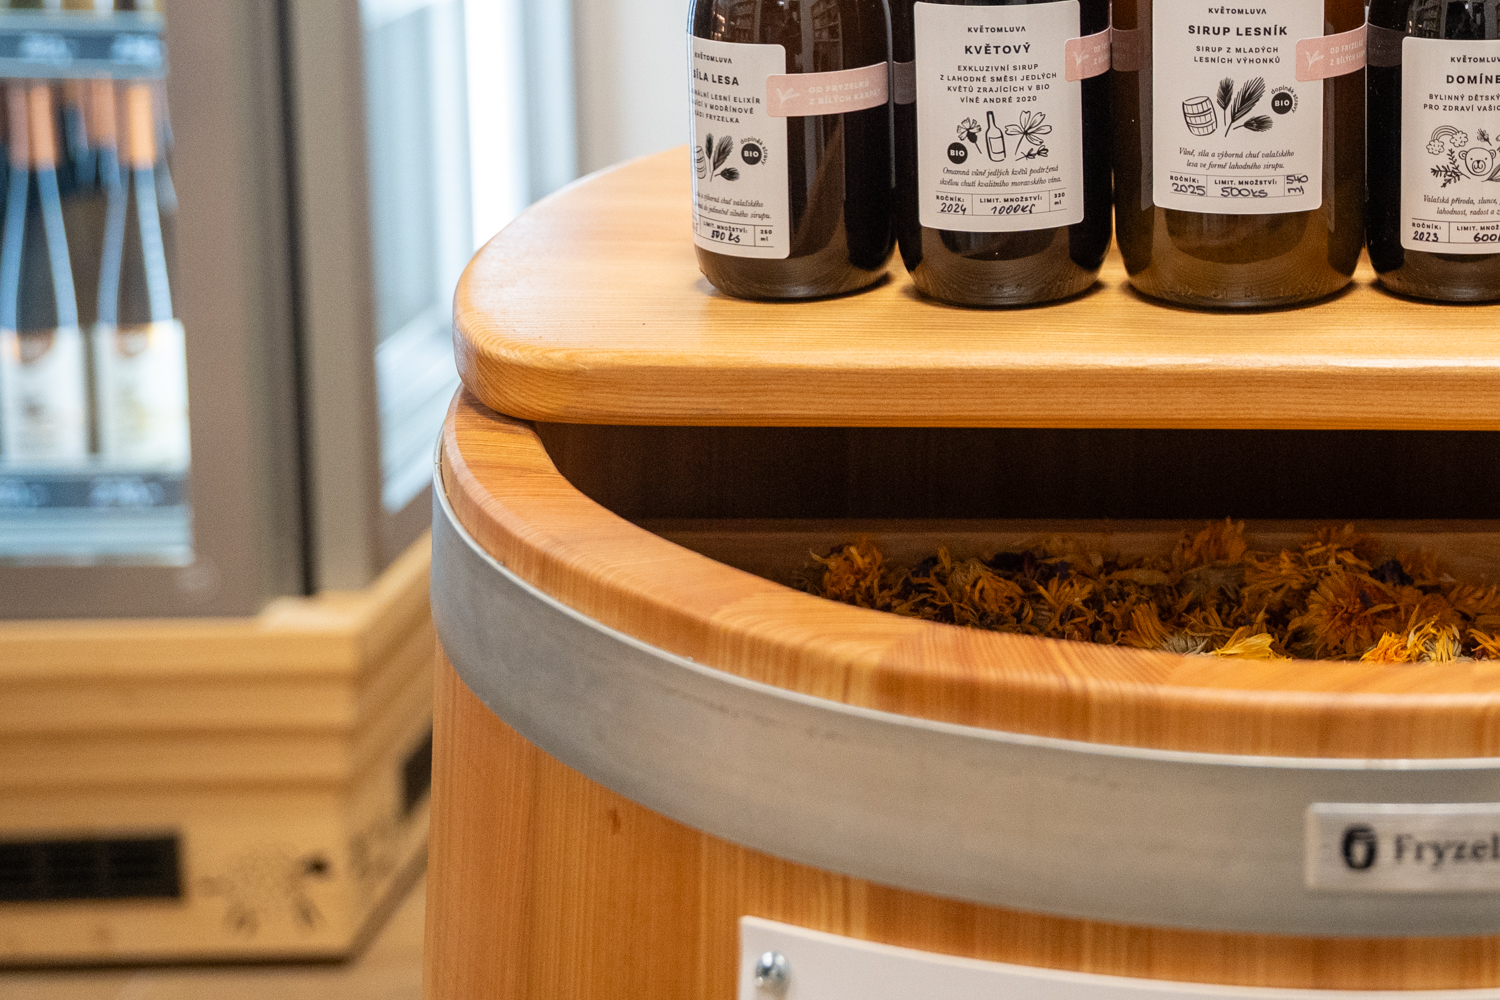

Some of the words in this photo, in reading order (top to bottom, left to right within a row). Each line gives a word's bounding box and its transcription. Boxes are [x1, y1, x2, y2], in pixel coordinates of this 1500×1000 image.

[1208, 6, 1267, 15] KVĚTOMLUVA
[968, 25, 1026, 33] KVĚTOMLUVA
[1188, 25, 1231, 36] SIRUP
[1236, 25, 1288, 36] LESNÍK
[965, 42, 1031, 54] KVĚTOVÝ
[1194, 56, 1232, 64] LESNÍCH
[1236, 56, 1280, 64] VÝHONKŮ
[958, 64, 1009, 72] EXKLUZIVNÍ
[712, 74, 739, 86] LESA
[1021, 72, 1056, 81] JEDLÝCH
[809, 86, 822, 94] OD
[711, 94, 731, 102] LESNÍ
[733, 96, 761, 104] ELIXÍR
[1429, 93, 1464, 101] BYLINNÝ
[1468, 93, 1500, 101] DĚTSKÝ
[1274, 99, 1290, 107] BIO
[710, 104, 754, 114] MODŘÍNOVÉ
[1443, 104, 1474, 112] ZDRAVÍ
[706, 113, 740, 123] FRYZELKA
[1217, 150, 1243, 160] výborná
[1187, 159, 1198, 168] lesa
[1206, 162, 1227, 170] formě
[1229, 161, 1261, 170] lahodného
[1263, 162, 1284, 171] sirupu.
[943, 167, 969, 176] Omamná
[986, 168, 1009, 178] jedlých
[1029, 165, 1058, 176] podtržená
[1170, 175, 1199, 183] ROČNÍK:
[1286, 175, 1309, 184] 540
[1172, 183, 1206, 196] 2025
[1004, 194, 1042, 203] MNOŽSTVÍ:
[940, 203, 966, 215] 2024
[1412, 222, 1441, 230] ROČNÍK:
[1412, 231, 1439, 242] 2023
